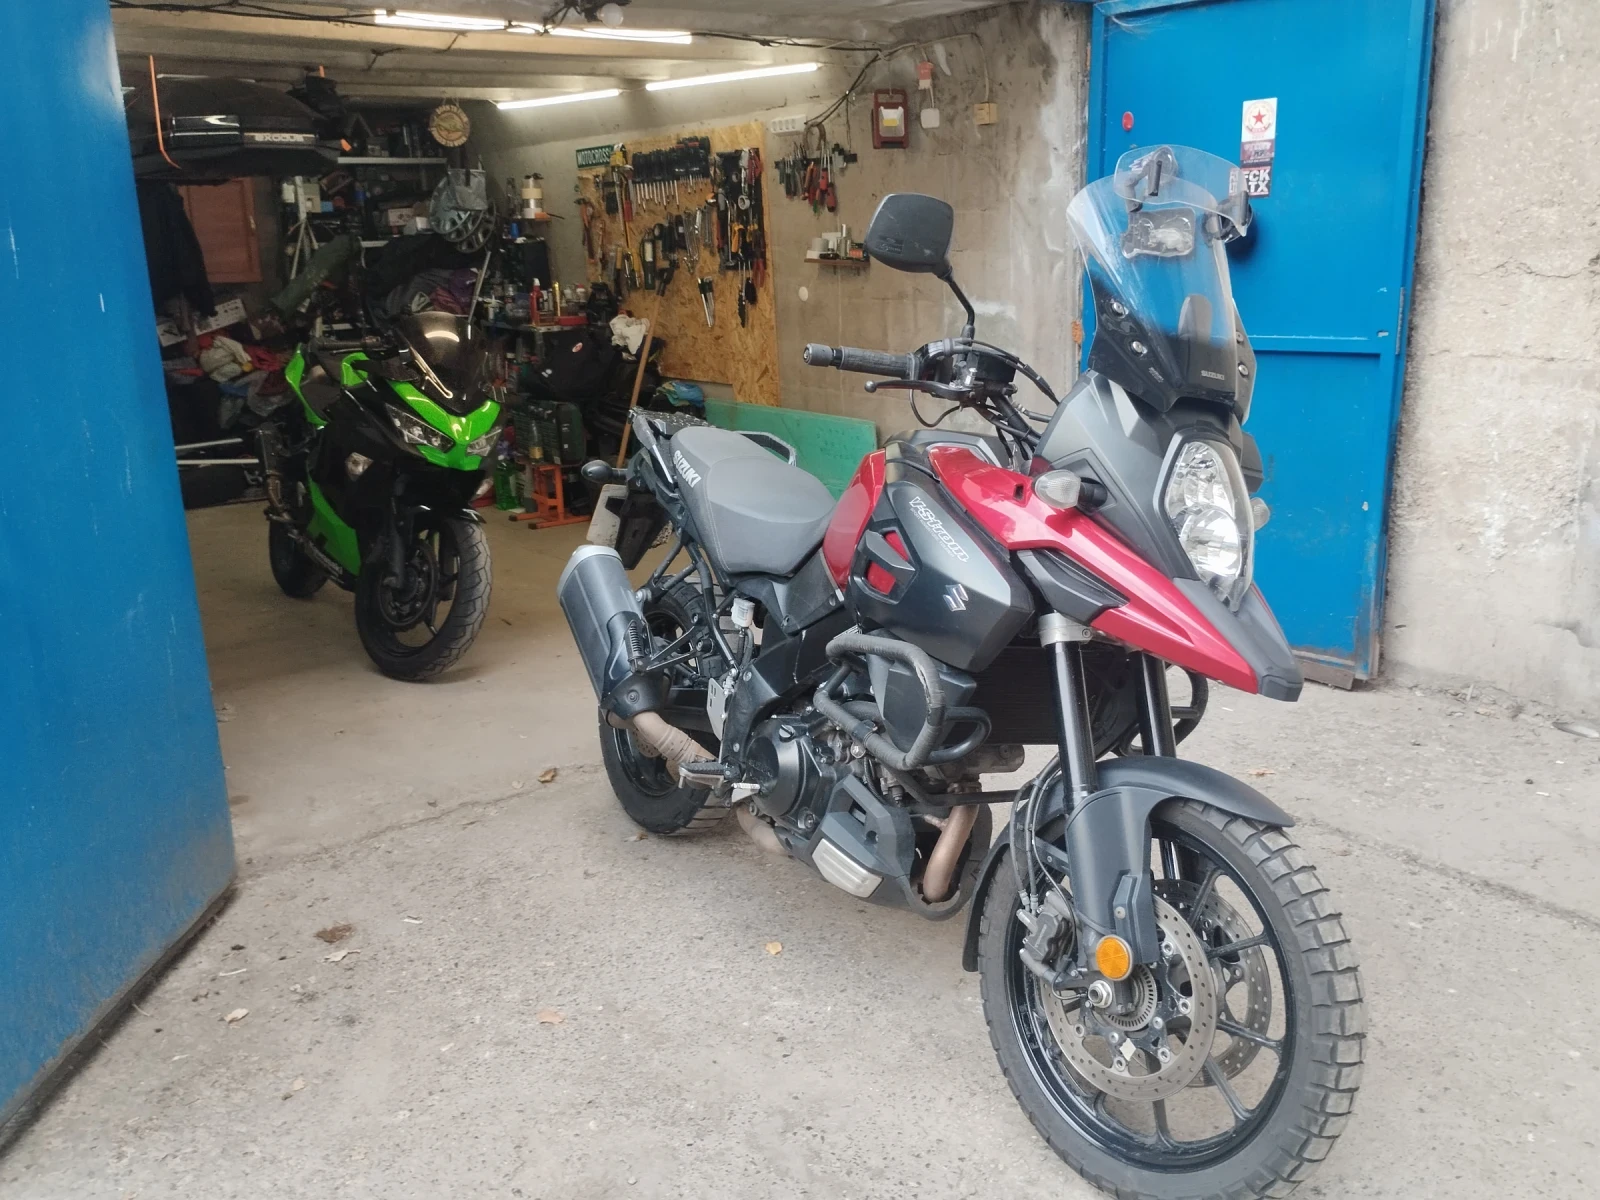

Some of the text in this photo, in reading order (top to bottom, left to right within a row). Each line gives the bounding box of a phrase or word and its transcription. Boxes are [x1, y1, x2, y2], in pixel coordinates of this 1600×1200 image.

[1247, 180, 1269, 193] TX
[1200, 369, 1225, 381] SUZUKI
[673, 450, 702, 488] SUZUKI
